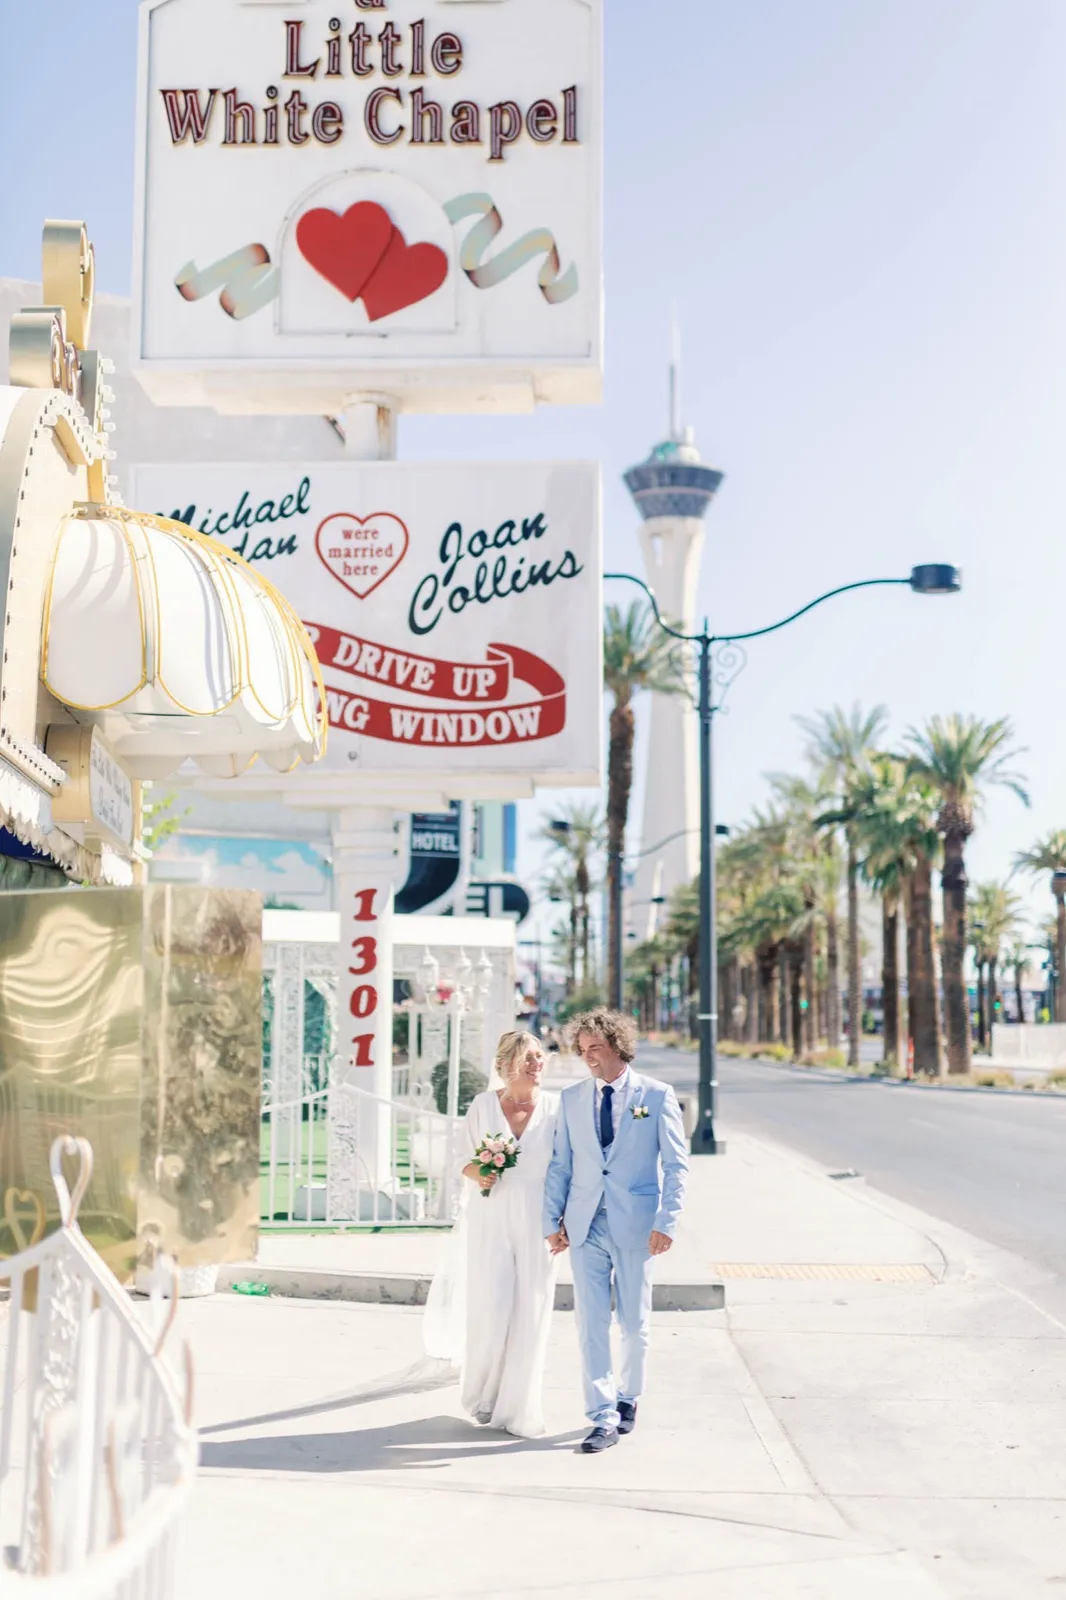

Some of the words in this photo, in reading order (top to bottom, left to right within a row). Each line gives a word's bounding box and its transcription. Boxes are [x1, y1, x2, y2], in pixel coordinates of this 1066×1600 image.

[282, 16, 465, 80] Little
[159, 85, 345, 146] White
[364, 84, 580, 162] Chapel
[328, 543, 393, 558] married
[342, 529, 379, 540] were
[439, 512, 548, 587] Joan
[343, 561, 378, 576] here
[408, 550, 584, 636] Collins
[332, 635, 436, 691] DRIVE
[452, 666, 497, 697] UP
[389, 705, 542, 744] WINDOW
[412, 831, 459, 852] HOTEL
[348, 888, 378, 1067] 1301
